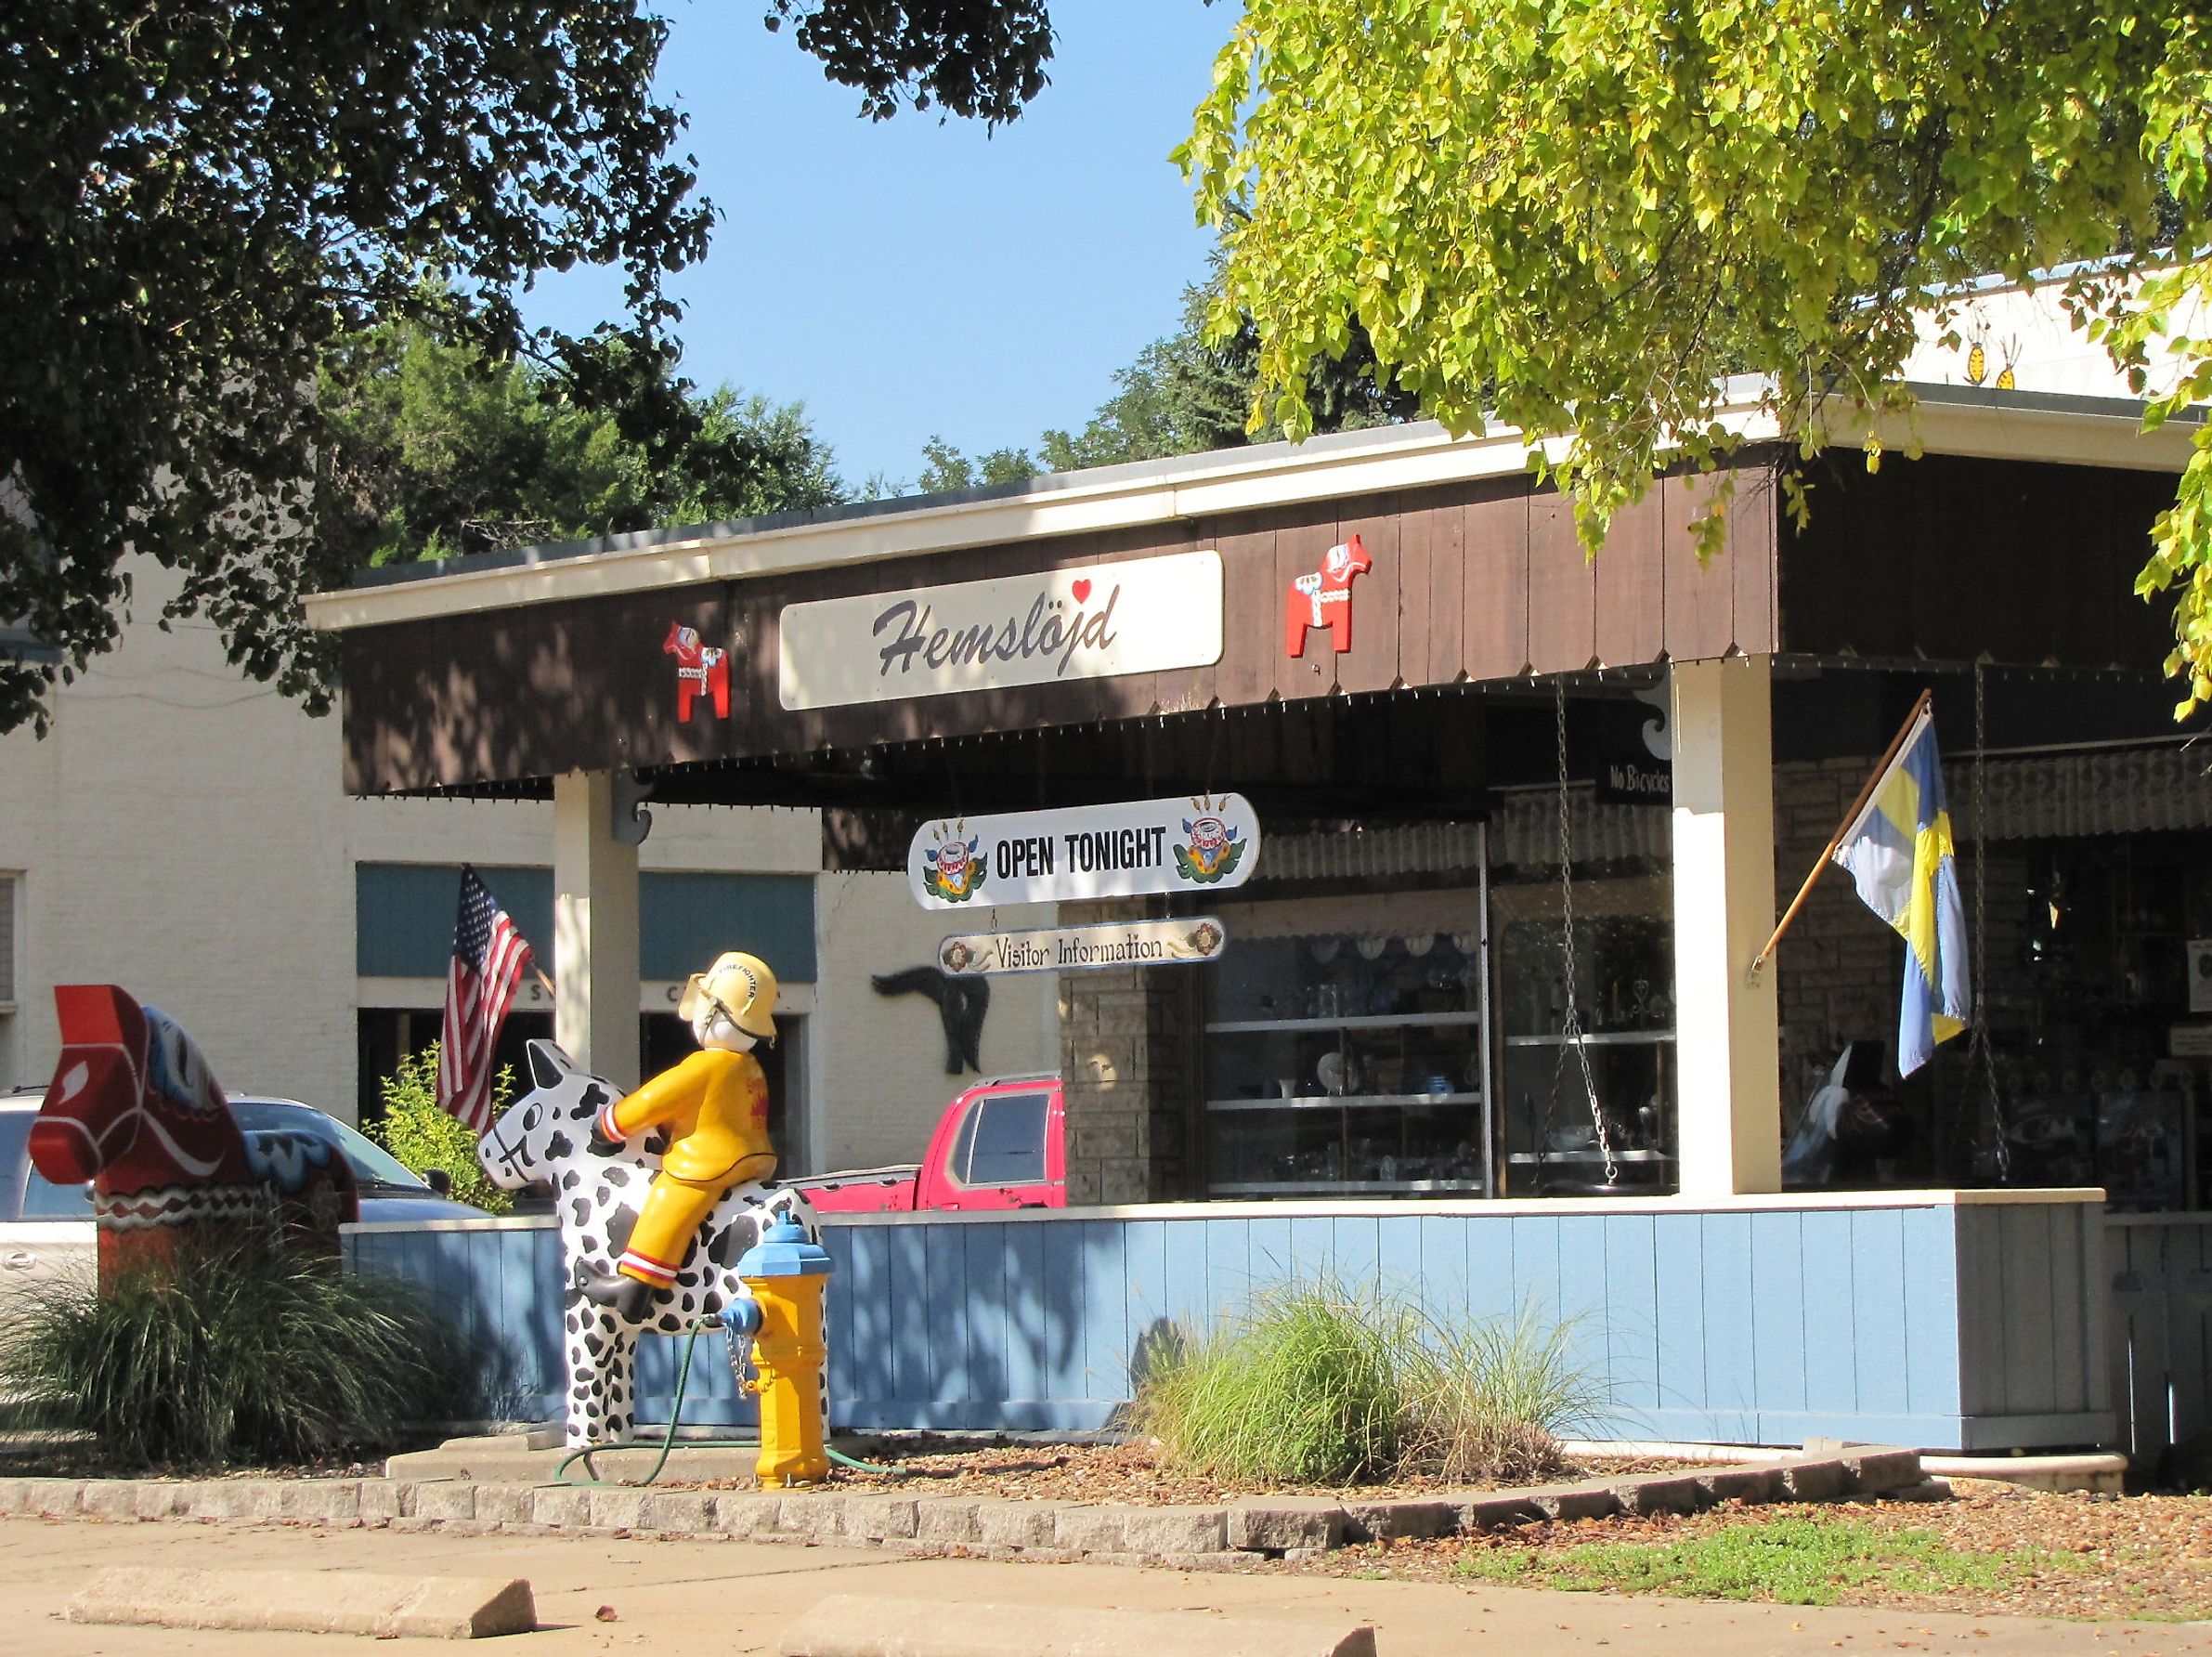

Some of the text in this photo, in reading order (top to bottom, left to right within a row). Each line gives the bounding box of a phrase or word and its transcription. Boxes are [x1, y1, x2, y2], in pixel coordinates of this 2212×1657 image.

[873, 583, 1120, 676] Hemslöjd
[1610, 764, 1625, 789] No
[996, 826, 1166, 879] OPEN TONIGHT
[995, 933, 1163, 968] Visitor Information
[719, 964, 757, 999] FIREFIGHTER
